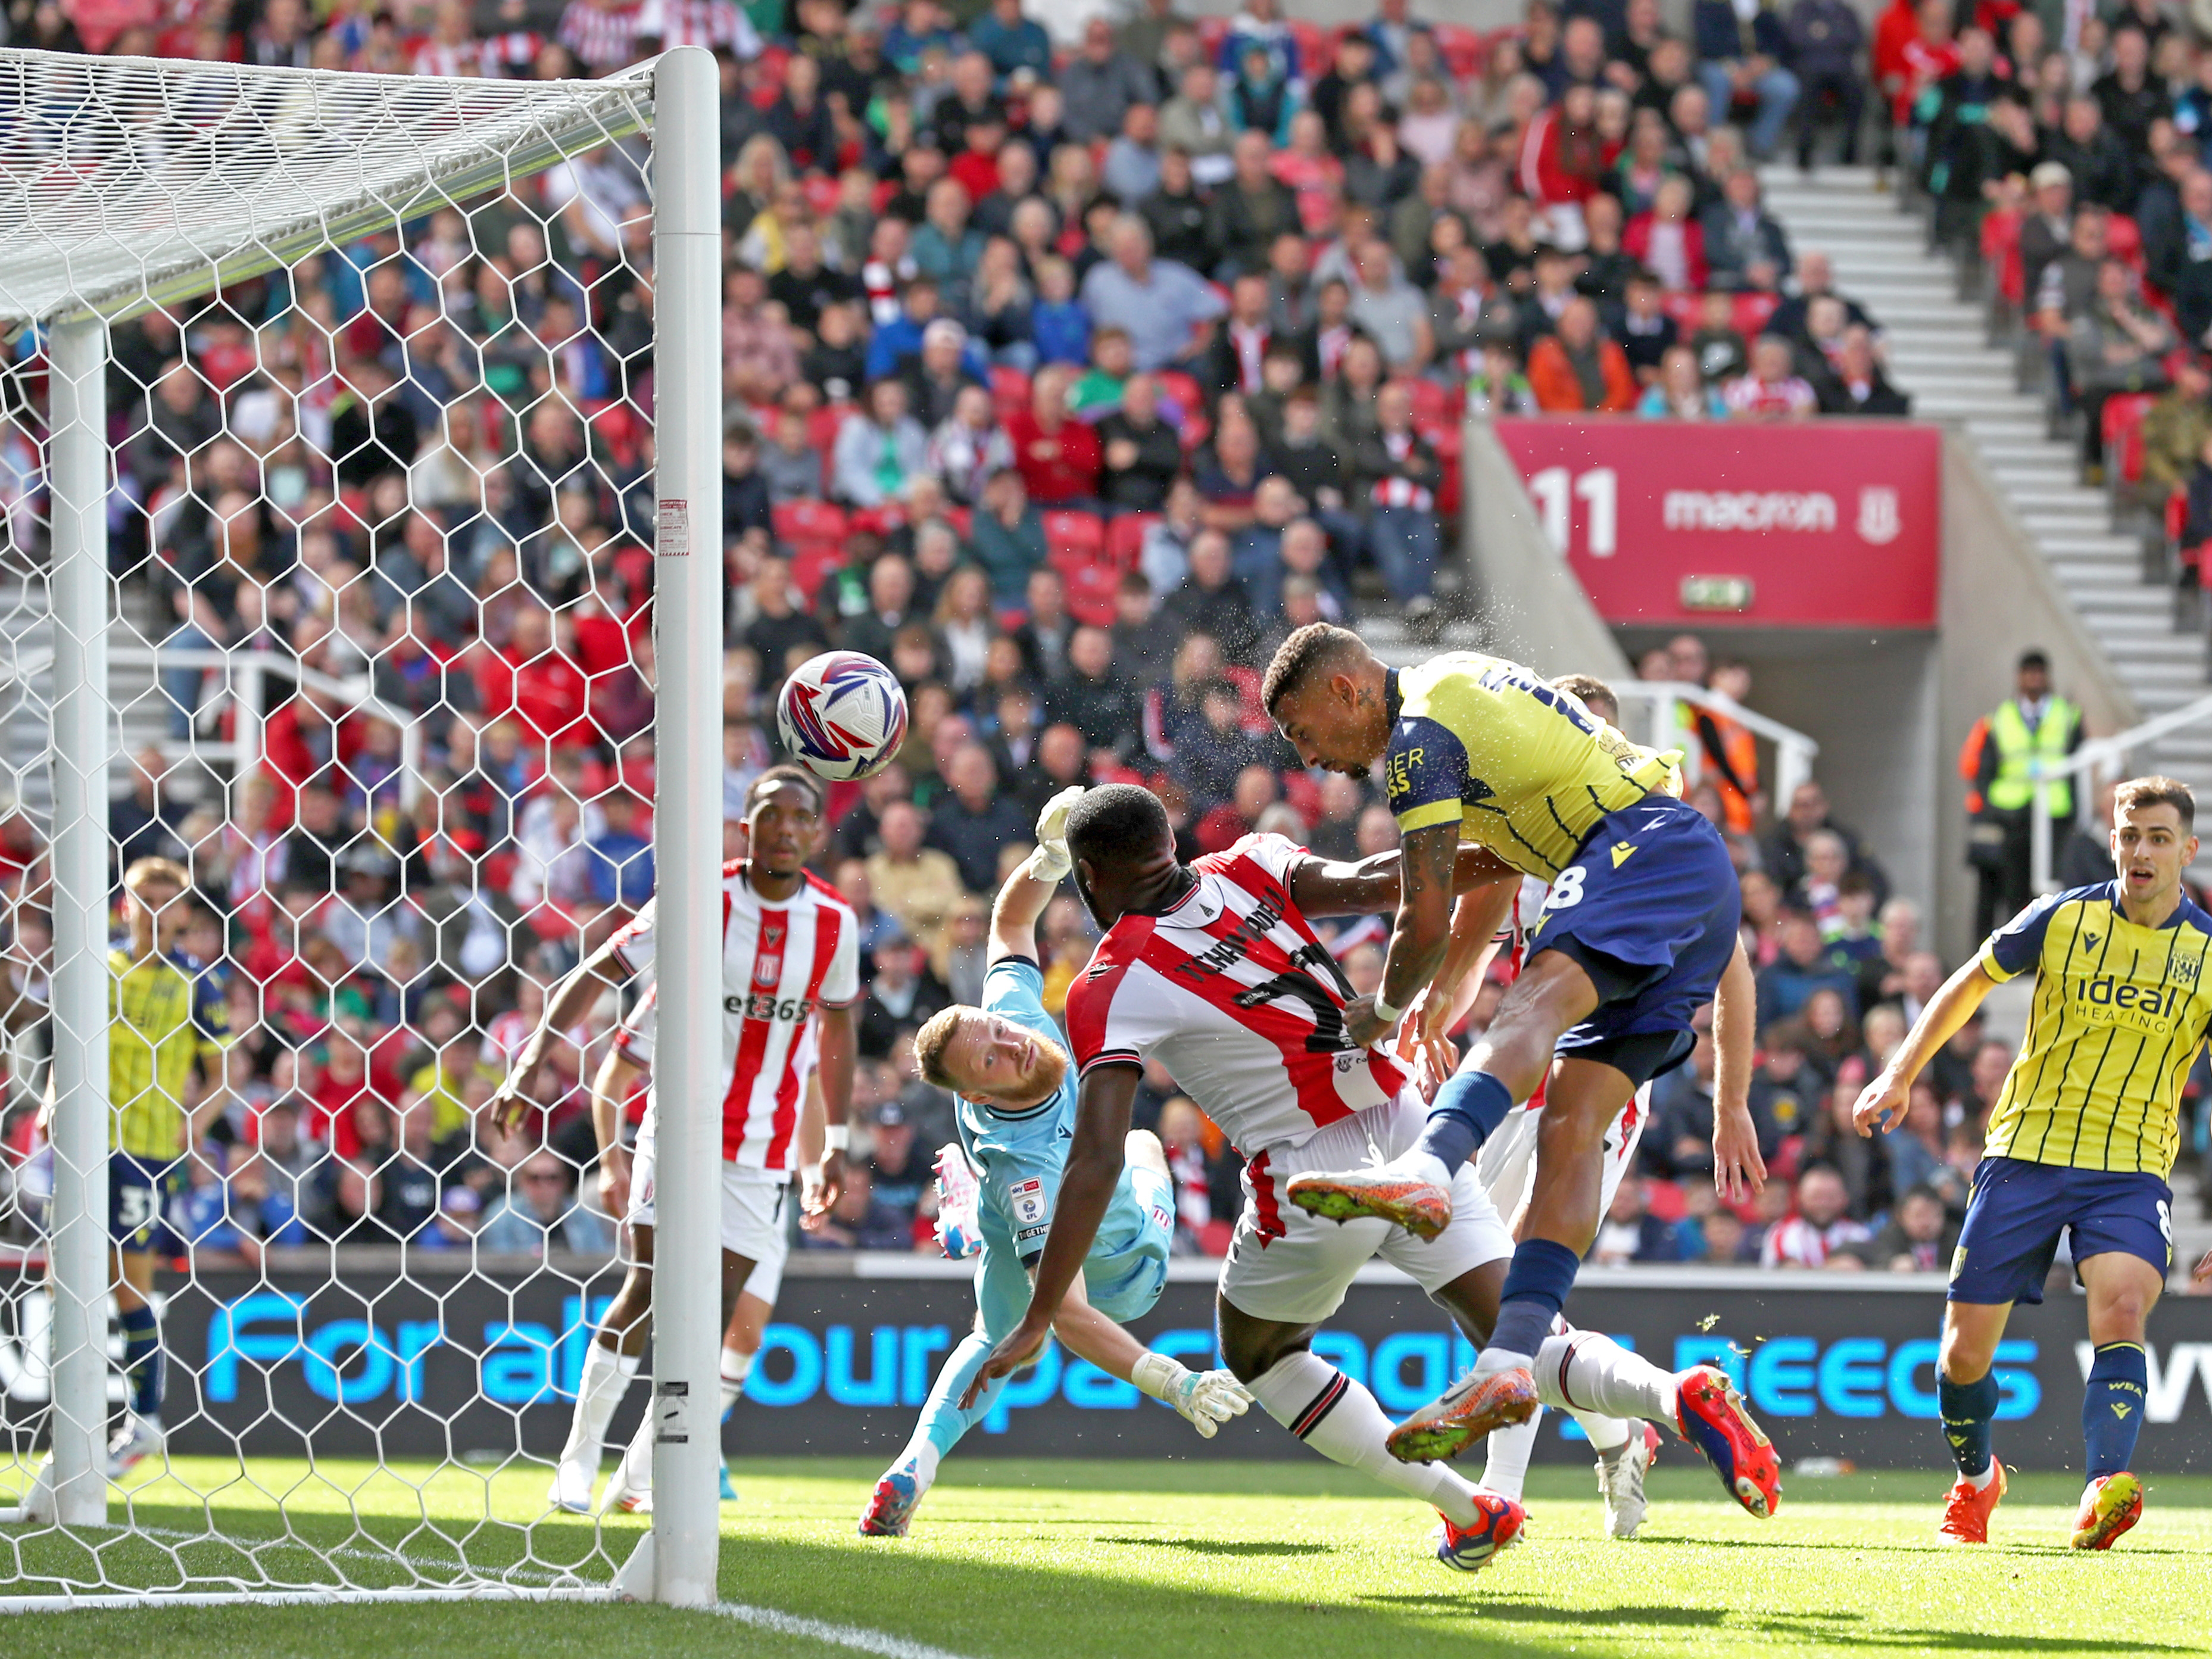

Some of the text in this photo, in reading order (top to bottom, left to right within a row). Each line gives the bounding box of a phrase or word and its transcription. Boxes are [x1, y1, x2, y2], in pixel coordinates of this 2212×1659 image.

[1529, 466, 1618, 558] 11
[1663, 488, 1837, 533] macron
[1539, 865, 1587, 916] 8
[724, 994, 810, 1022] et365
[2076, 1004, 2167, 1033] HEATING
[2078, 975, 2177, 1018] ideal
[2156, 1199, 2172, 1246] 8
[207, 1292, 448, 1404] For
[481, 1295, 616, 1404] al
[722, 1323, 950, 1424] our
